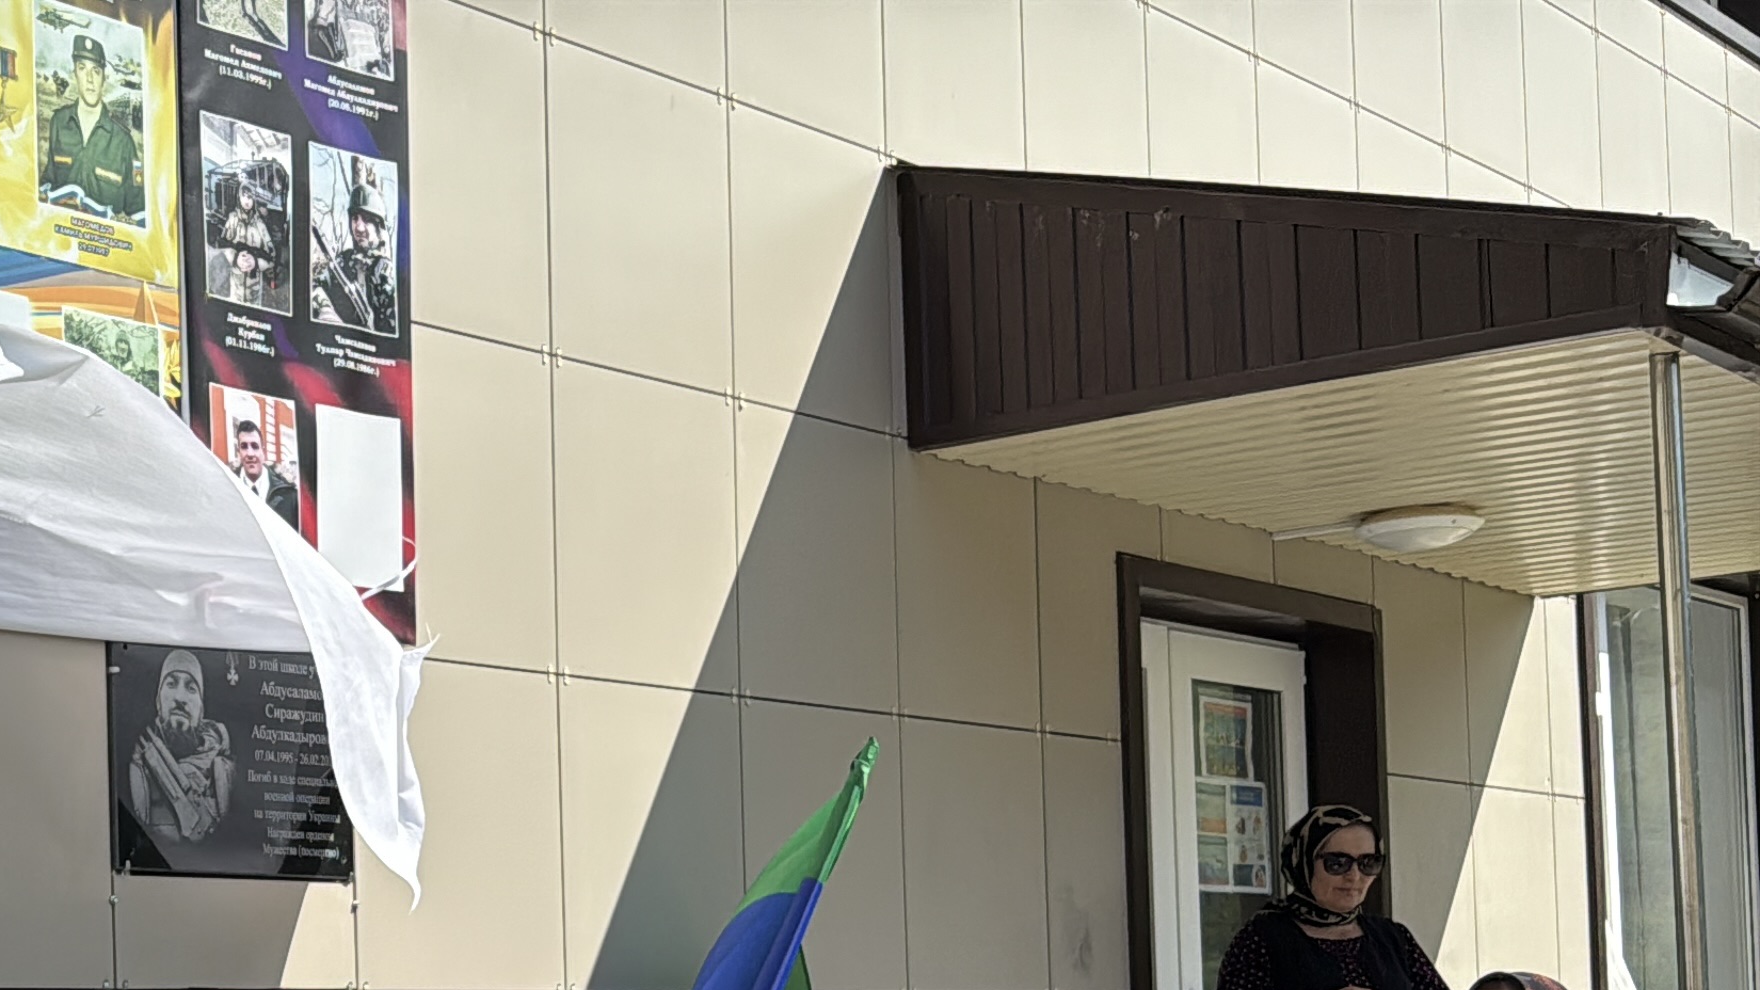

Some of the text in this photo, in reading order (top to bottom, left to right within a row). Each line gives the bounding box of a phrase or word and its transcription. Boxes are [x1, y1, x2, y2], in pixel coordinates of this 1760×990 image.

[248, 655, 257, 670] В
[259, 659, 279, 672] этой
[280, 664, 308, 675] школе
[260, 681, 323, 701] Абдусаламо
[265, 703, 325, 725] Сиражудин
[251, 724, 328, 747] Абдулкадыров
[247, 769, 272, 783] Погиб
[279, 776, 296, 785] ходе
[254, 809, 263, 819] на
[265, 810, 307, 824] территории
[262, 843, 298, 858] Мужества
